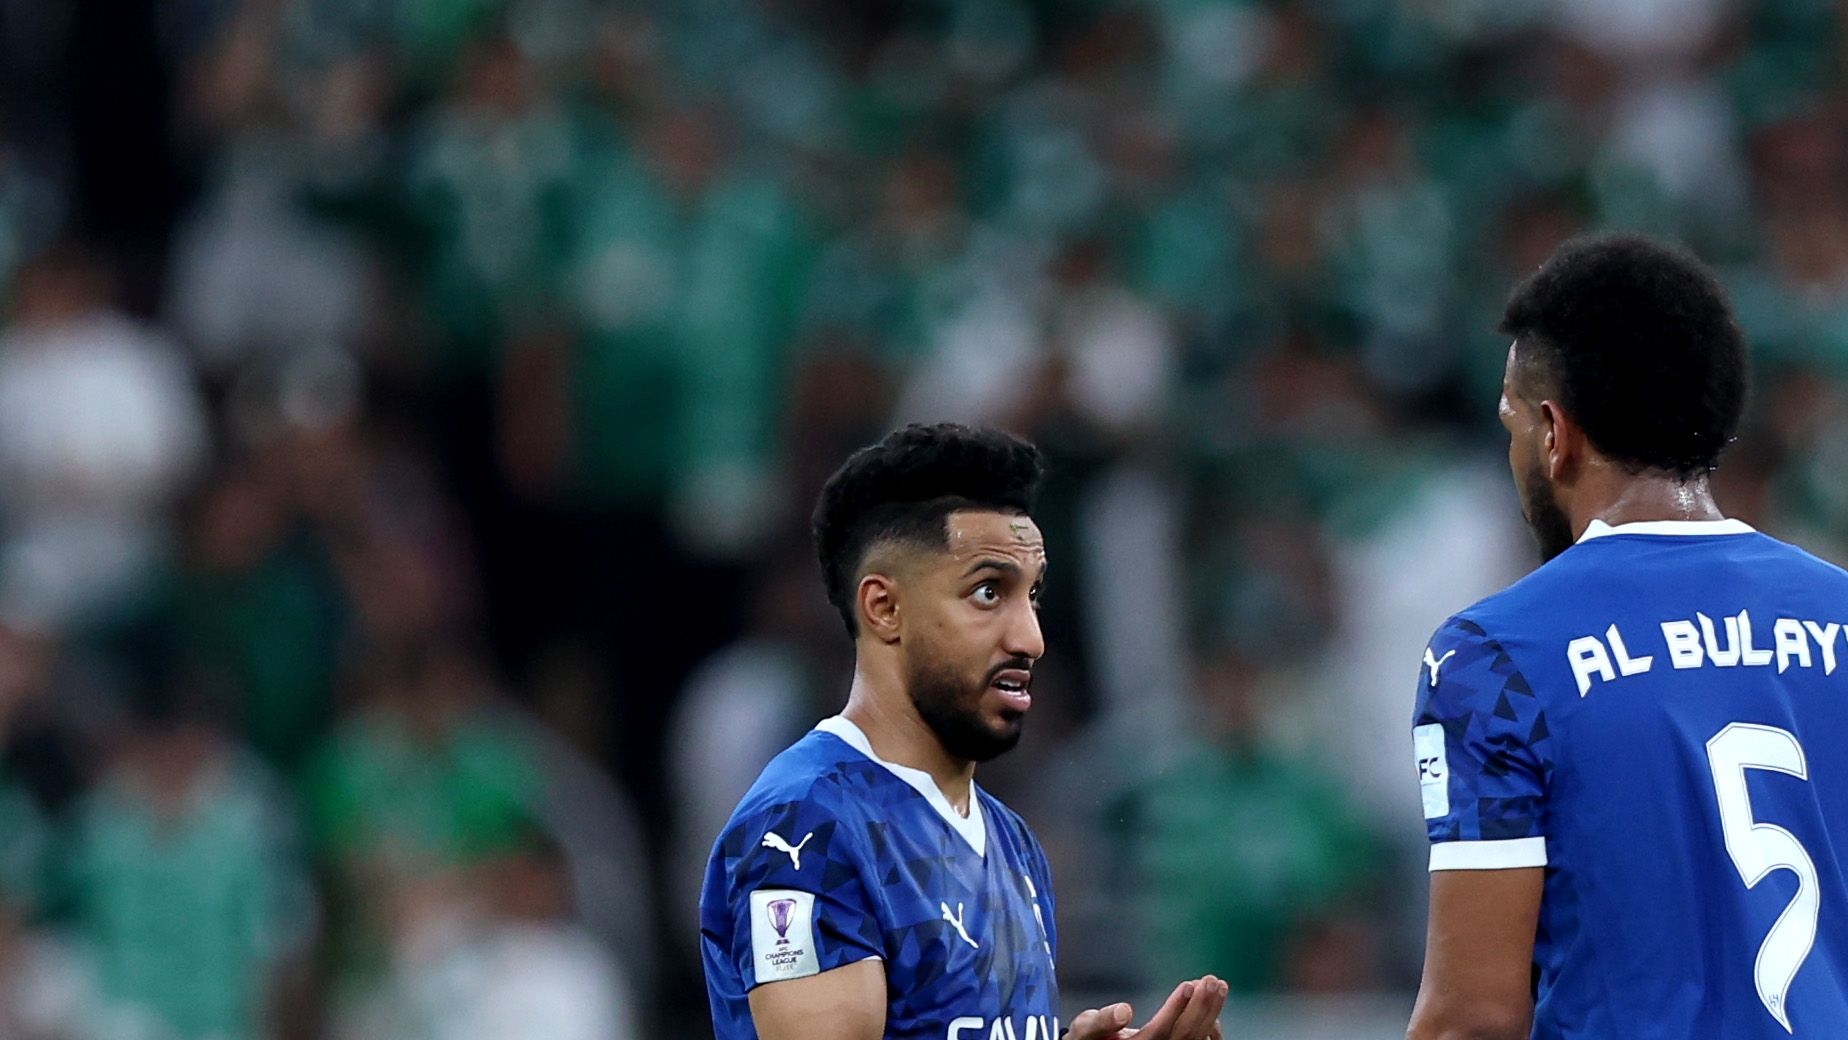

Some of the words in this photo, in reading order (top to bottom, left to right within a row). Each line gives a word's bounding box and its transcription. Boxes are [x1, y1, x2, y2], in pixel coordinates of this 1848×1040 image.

[1567, 624, 1653, 698] AL
[1706, 721, 1820, 1035] 5
[765, 949, 804, 960] CHAMPIONS
[772, 956, 797, 966] LEAGUE
